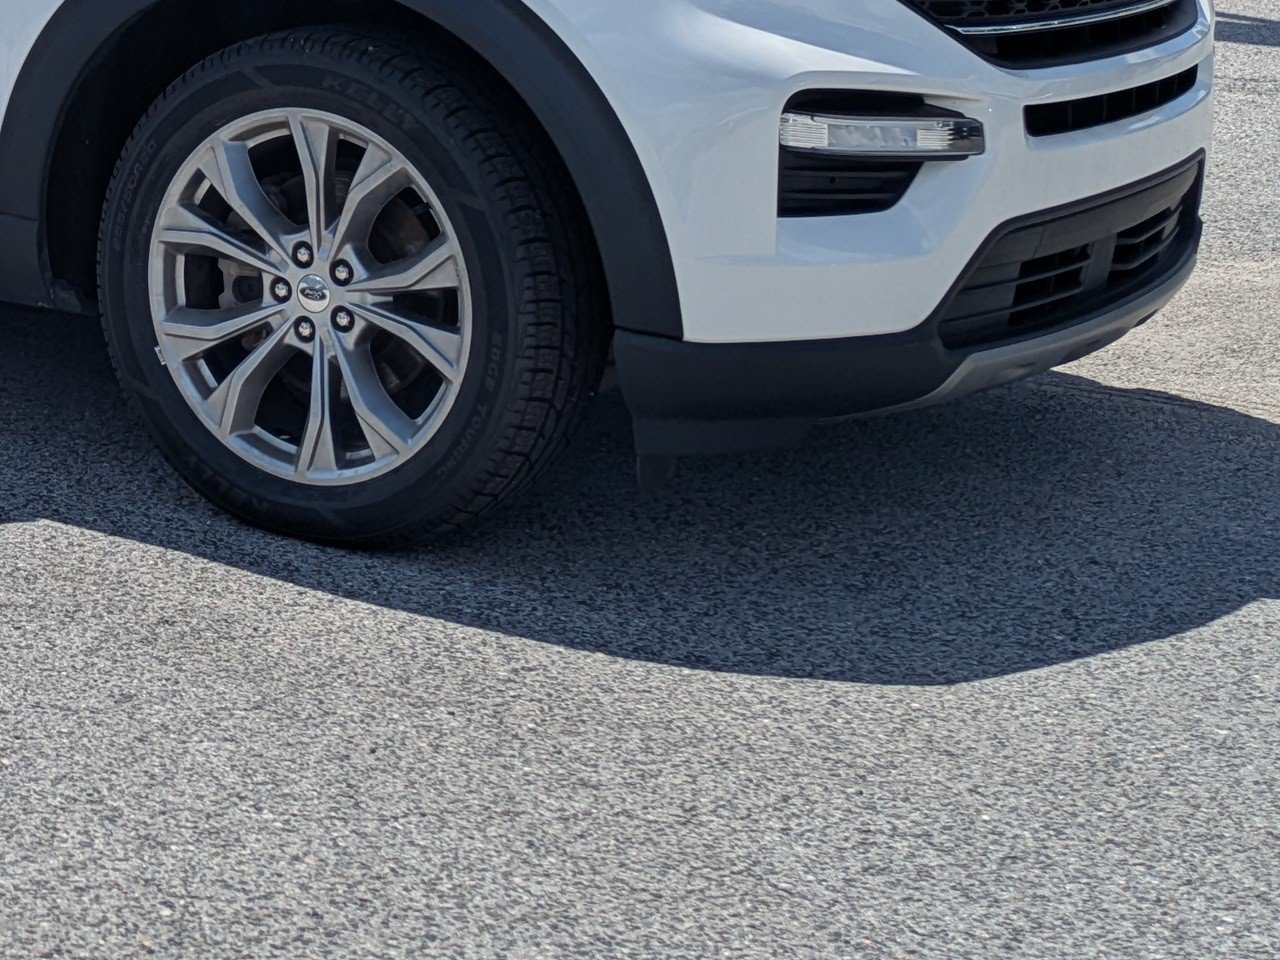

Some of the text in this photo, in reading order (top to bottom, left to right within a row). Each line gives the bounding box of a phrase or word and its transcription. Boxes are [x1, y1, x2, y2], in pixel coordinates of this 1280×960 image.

[320, 74, 418, 129] KELLY
[436, 331, 503, 477] EDGE TOURING
